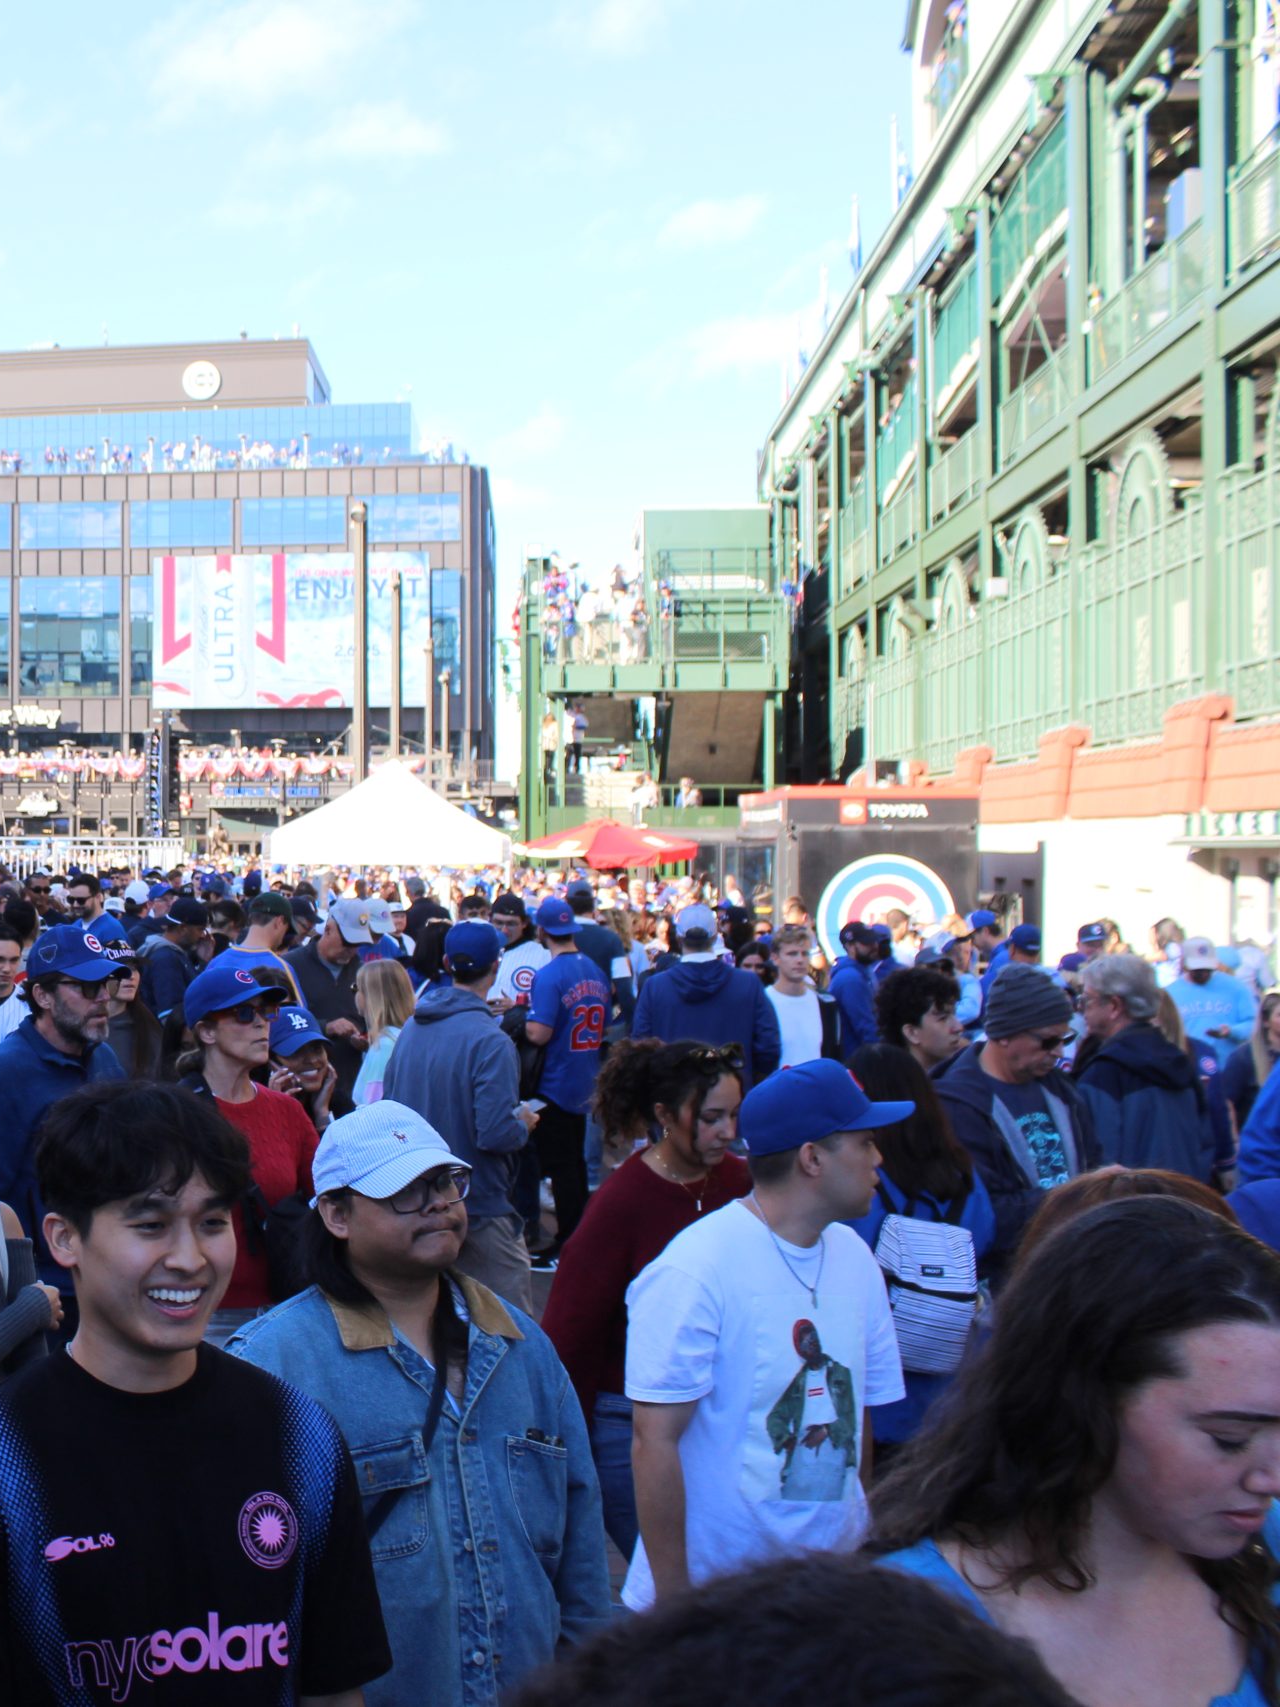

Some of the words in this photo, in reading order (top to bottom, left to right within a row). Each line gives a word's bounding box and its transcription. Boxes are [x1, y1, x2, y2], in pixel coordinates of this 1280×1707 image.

[214, 584, 234, 682] ULTRA
[13, 704, 61, 729] Way
[868, 803, 929, 819] TOYOTA
[234, 969, 255, 984] C
[288, 1013, 309, 1030] LA
[570, 1003, 606, 1052] 29
